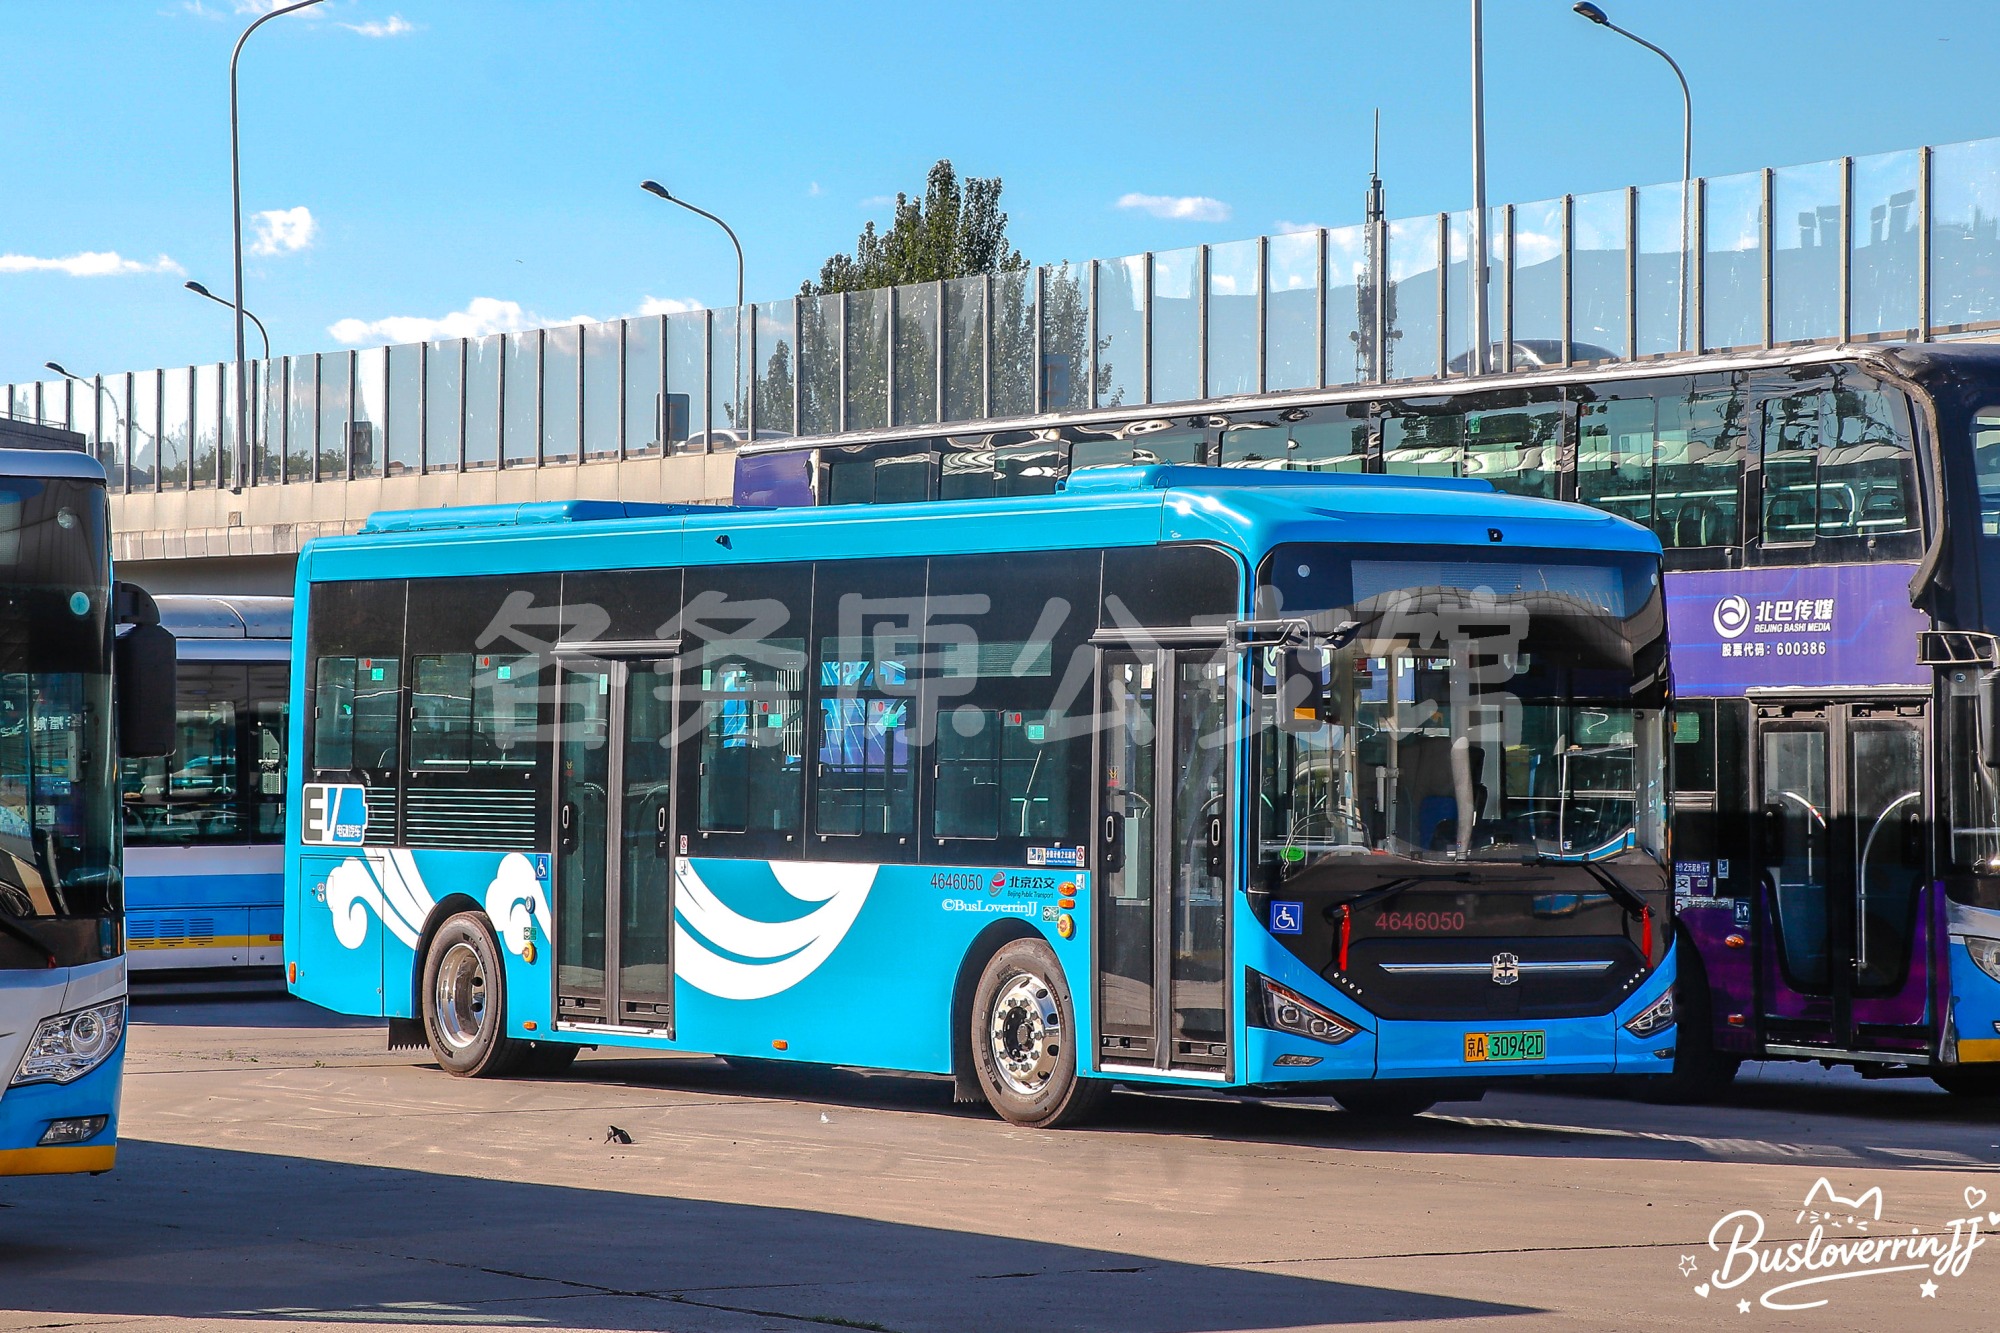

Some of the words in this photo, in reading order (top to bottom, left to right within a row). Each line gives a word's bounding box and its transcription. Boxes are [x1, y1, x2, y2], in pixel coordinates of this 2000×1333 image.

[1754, 599, 1834, 622] 北巴传媒
[1754, 624, 1783, 633] BEIJING
[1783, 623, 1807, 632] BASHI
[1807, 622, 1831, 632] MEDIA
[1776, 642, 1826, 655] 600386
[304, 787, 343, 841] EV
[930, 873, 983, 890] 4646050
[1009, 876, 1055, 889] 北京公交
[1007, 890, 1021, 898] Beijing
[1033, 891, 1054, 899] Transport
[1375, 912, 1465, 931] 4646050
